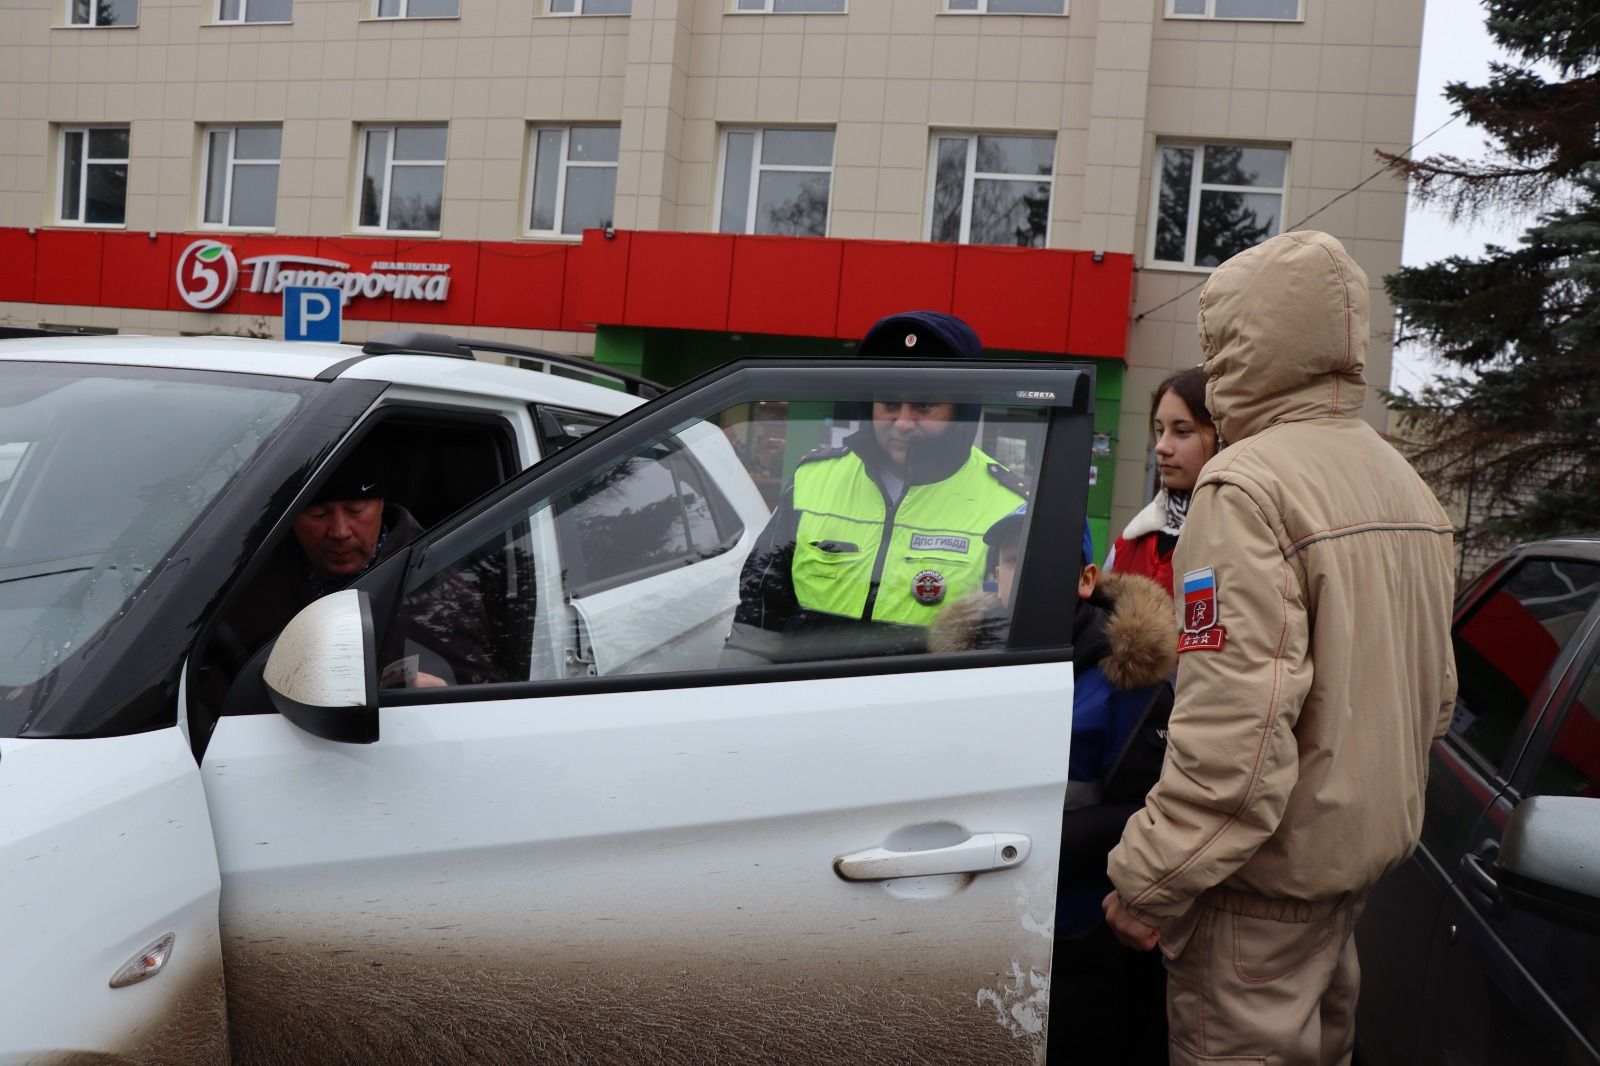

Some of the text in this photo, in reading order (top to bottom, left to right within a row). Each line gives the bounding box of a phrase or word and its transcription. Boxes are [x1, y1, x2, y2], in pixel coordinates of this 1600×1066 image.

[189, 260, 219, 302] 5
[300, 292, 331, 336] P
[913, 536, 966, 549] ДПС ГИБДД
